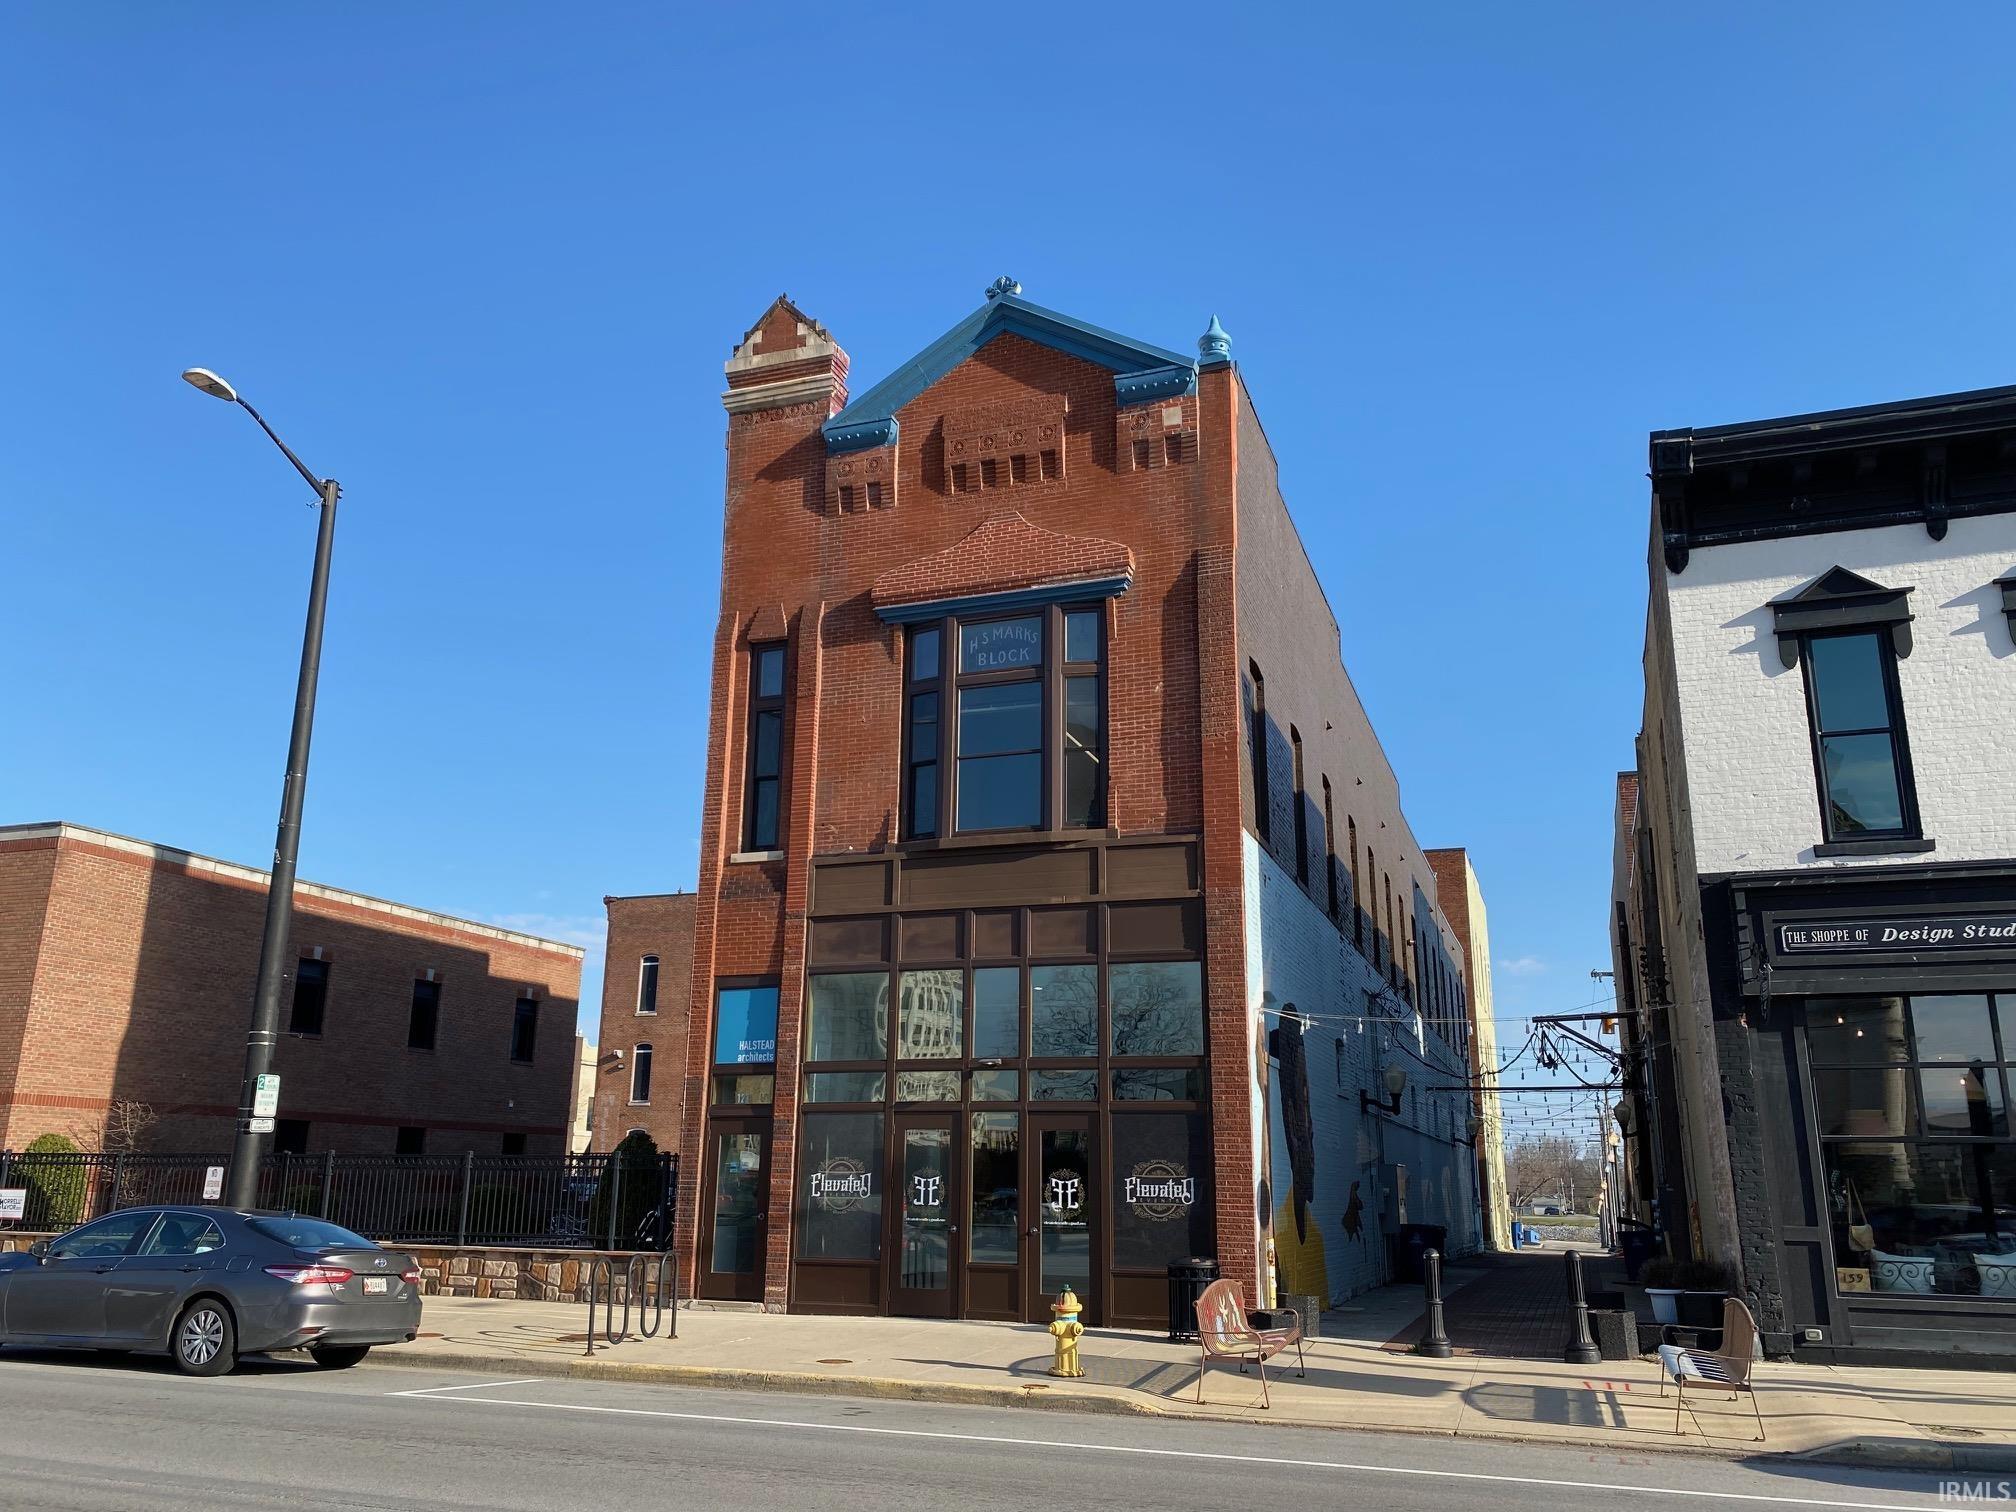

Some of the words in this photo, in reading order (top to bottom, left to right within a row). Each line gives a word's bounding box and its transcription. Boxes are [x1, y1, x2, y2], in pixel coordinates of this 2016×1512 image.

[970, 636, 978, 654] H
[982, 632, 989, 645] S
[992, 626, 1039, 644] MARKS
[978, 647, 1029, 666] BLOCK
[1786, 930, 1806, 943] THE
[1811, 929, 1850, 942] SHOPPE
[1855, 929, 1869, 941] OF
[1881, 926, 1954, 943] Design
[1962, 922, 2016, 939] Stud
[739, 1040, 775, 1051] HALSTEAD
[738, 1051, 774, 1062] architects
[259, 1077, 265, 1089] 2
